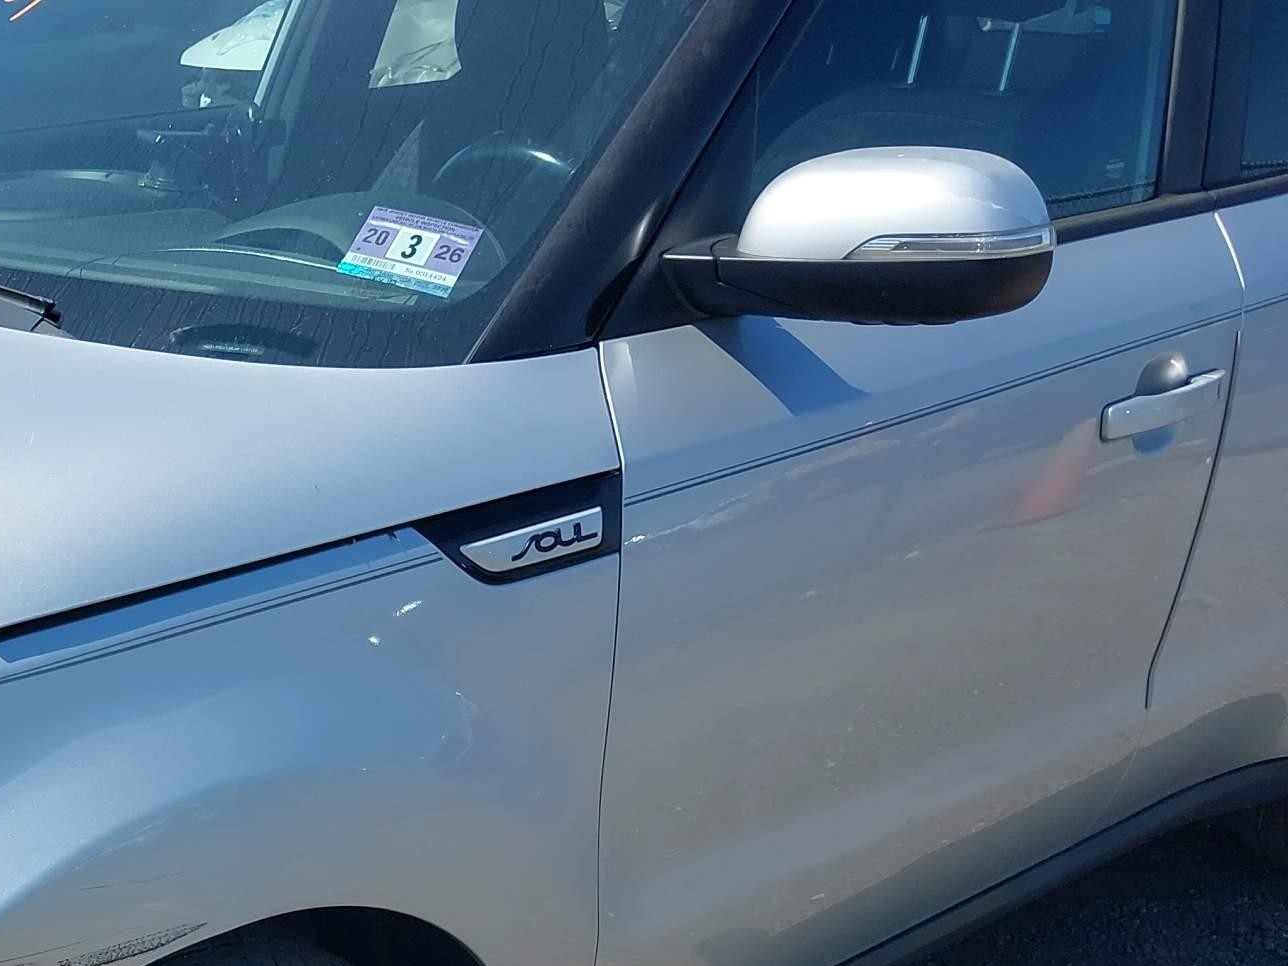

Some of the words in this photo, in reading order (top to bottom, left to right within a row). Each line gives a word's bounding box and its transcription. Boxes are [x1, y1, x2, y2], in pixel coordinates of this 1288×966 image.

[363, 227, 391, 247] 20
[401, 234, 423, 259] 3
[434, 244, 465, 264] 26
[511, 522, 598, 562] SOUL
